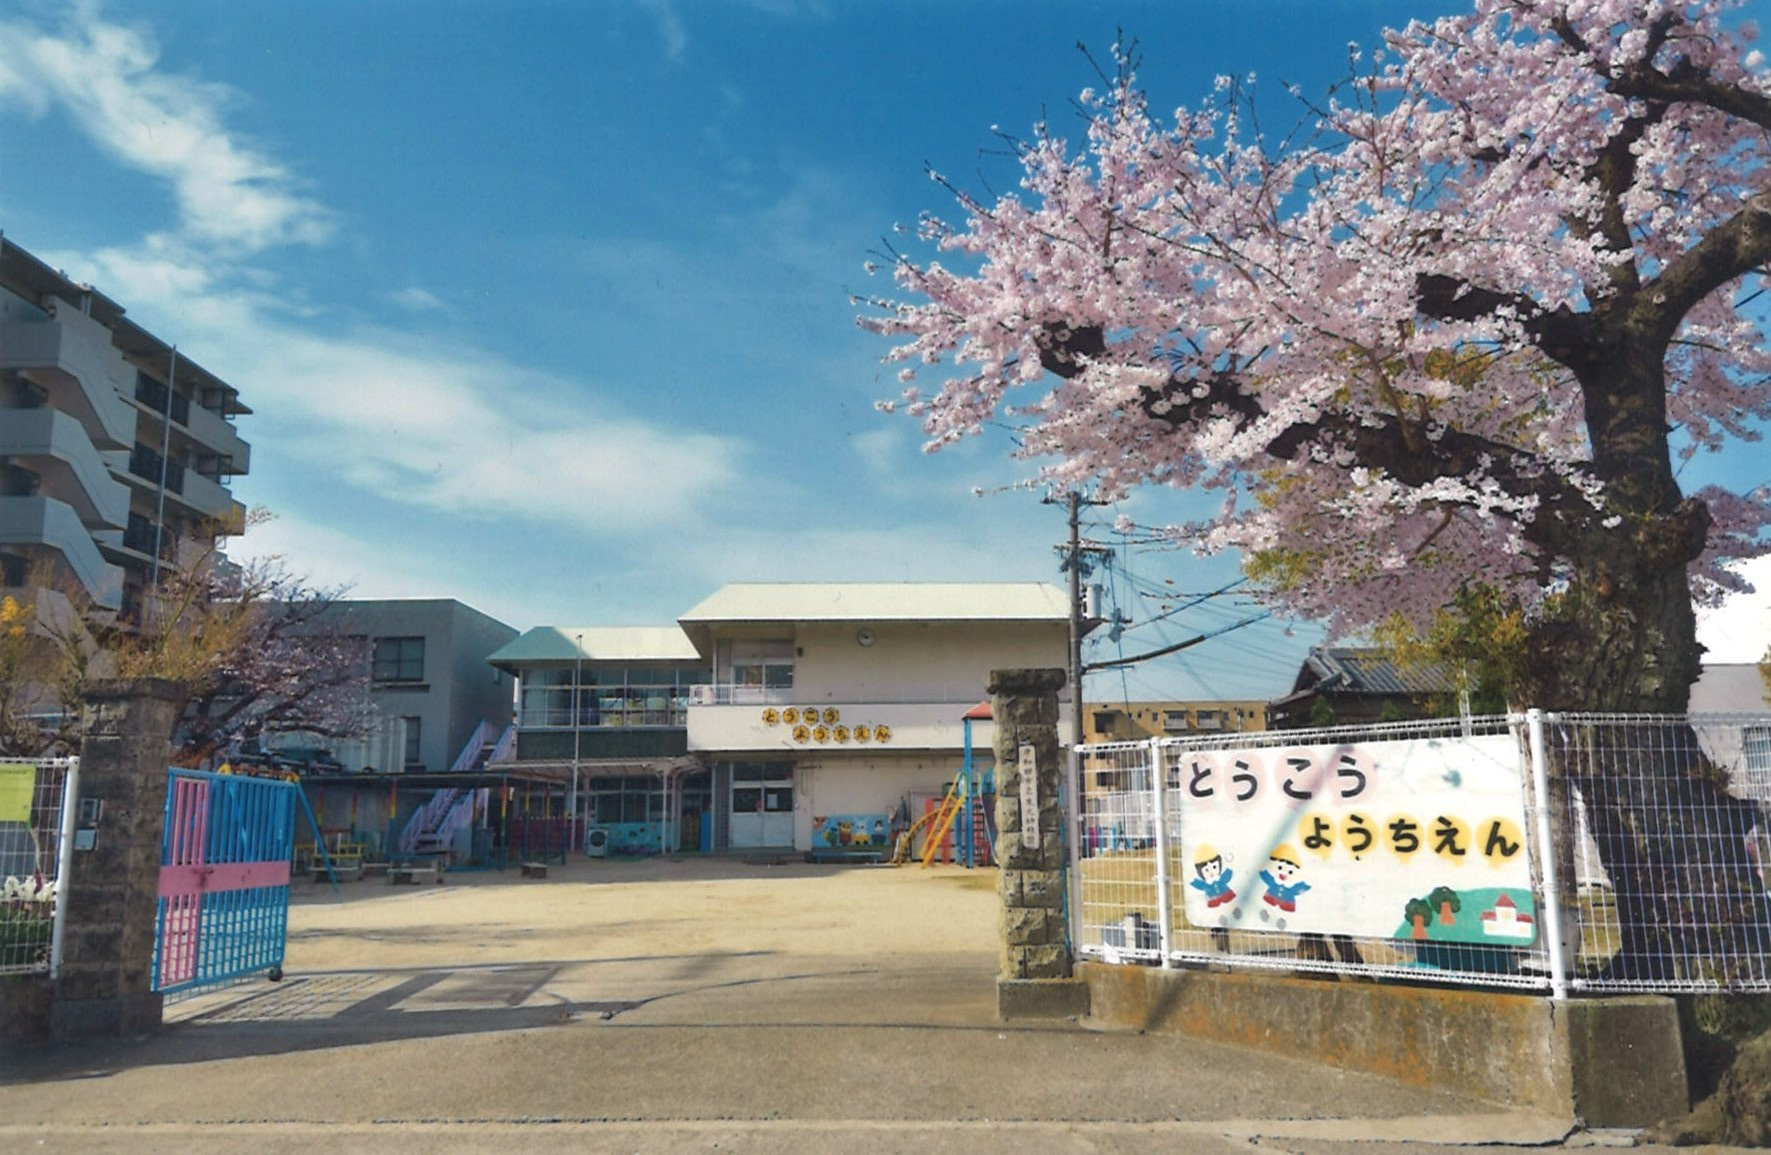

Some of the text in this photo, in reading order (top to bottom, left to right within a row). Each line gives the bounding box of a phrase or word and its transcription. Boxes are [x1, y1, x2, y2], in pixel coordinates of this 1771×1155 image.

[764, 709, 837, 722] とうこう
[795, 726, 889, 739] ようちえん
[1189, 754, 1366, 801] とうこう
[1303, 814, 1519, 857] ようちえん
